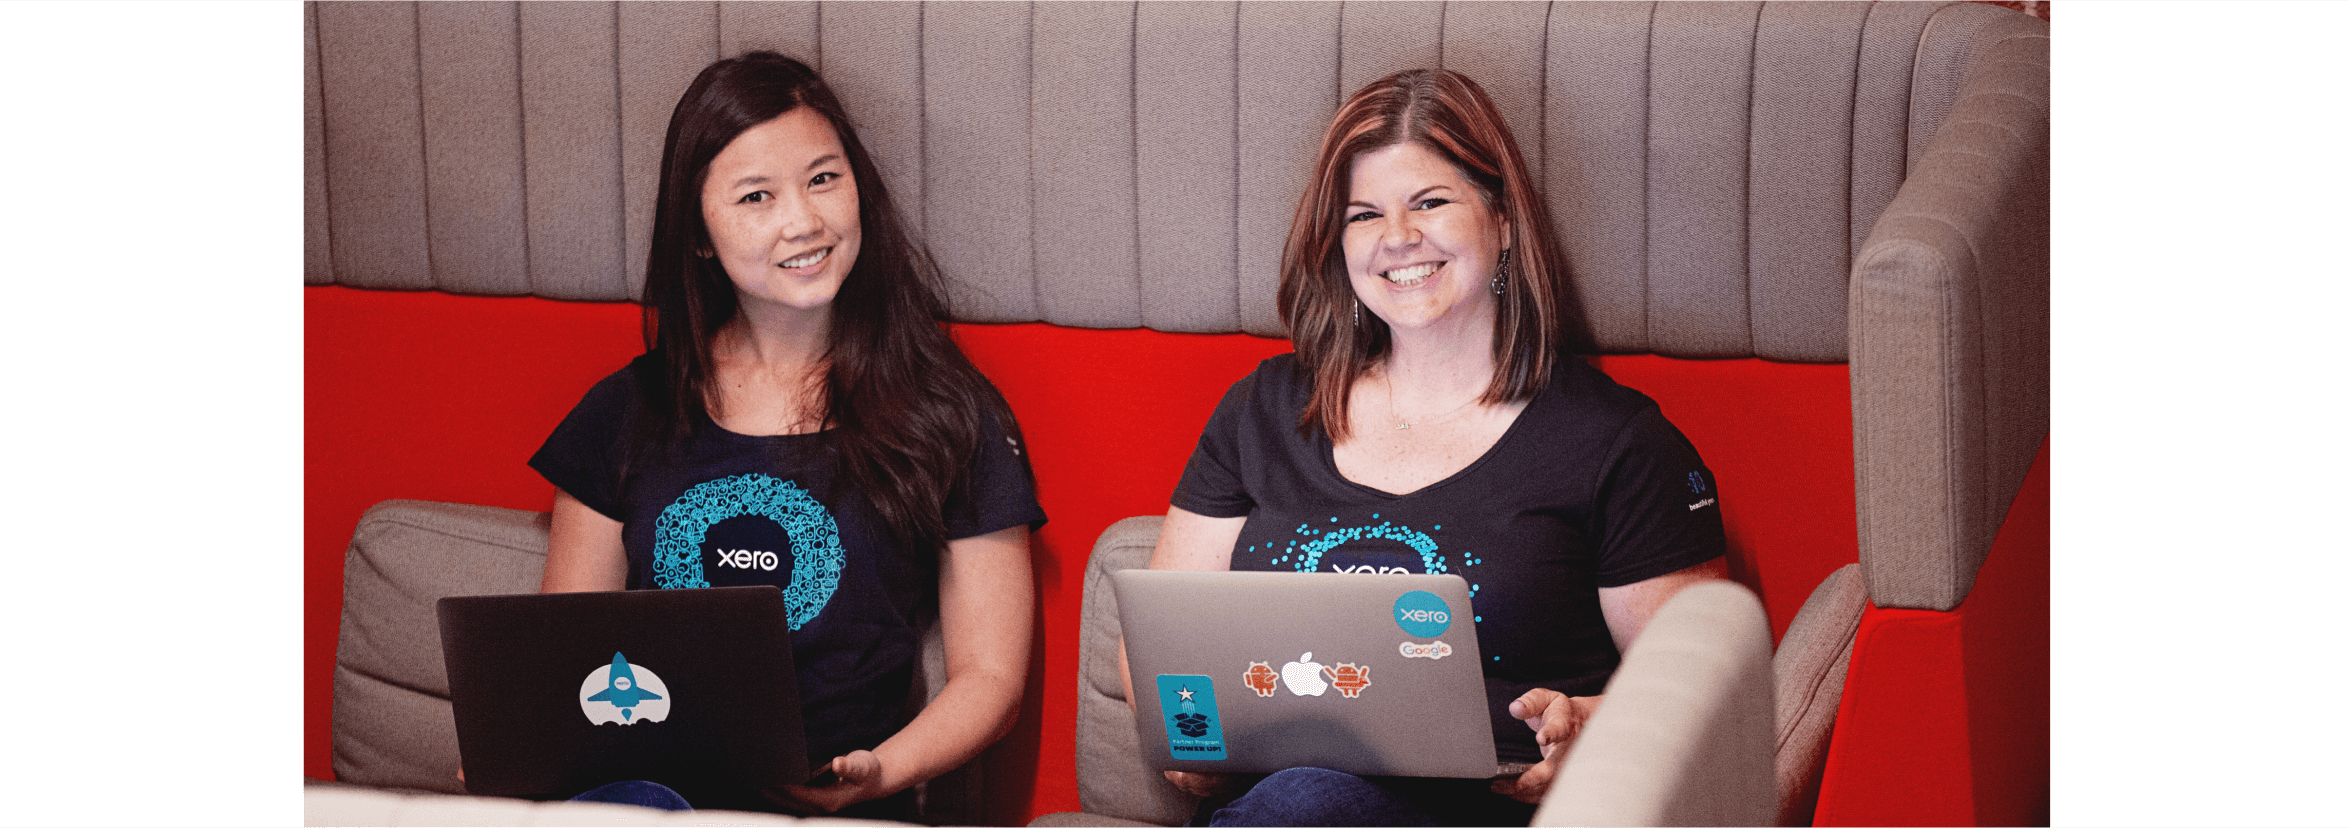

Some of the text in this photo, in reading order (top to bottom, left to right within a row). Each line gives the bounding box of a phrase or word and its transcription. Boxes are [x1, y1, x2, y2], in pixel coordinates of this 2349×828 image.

[717, 548, 778, 571] xero
[1401, 608, 1448, 623] xero
[1403, 644, 1448, 656] Google
